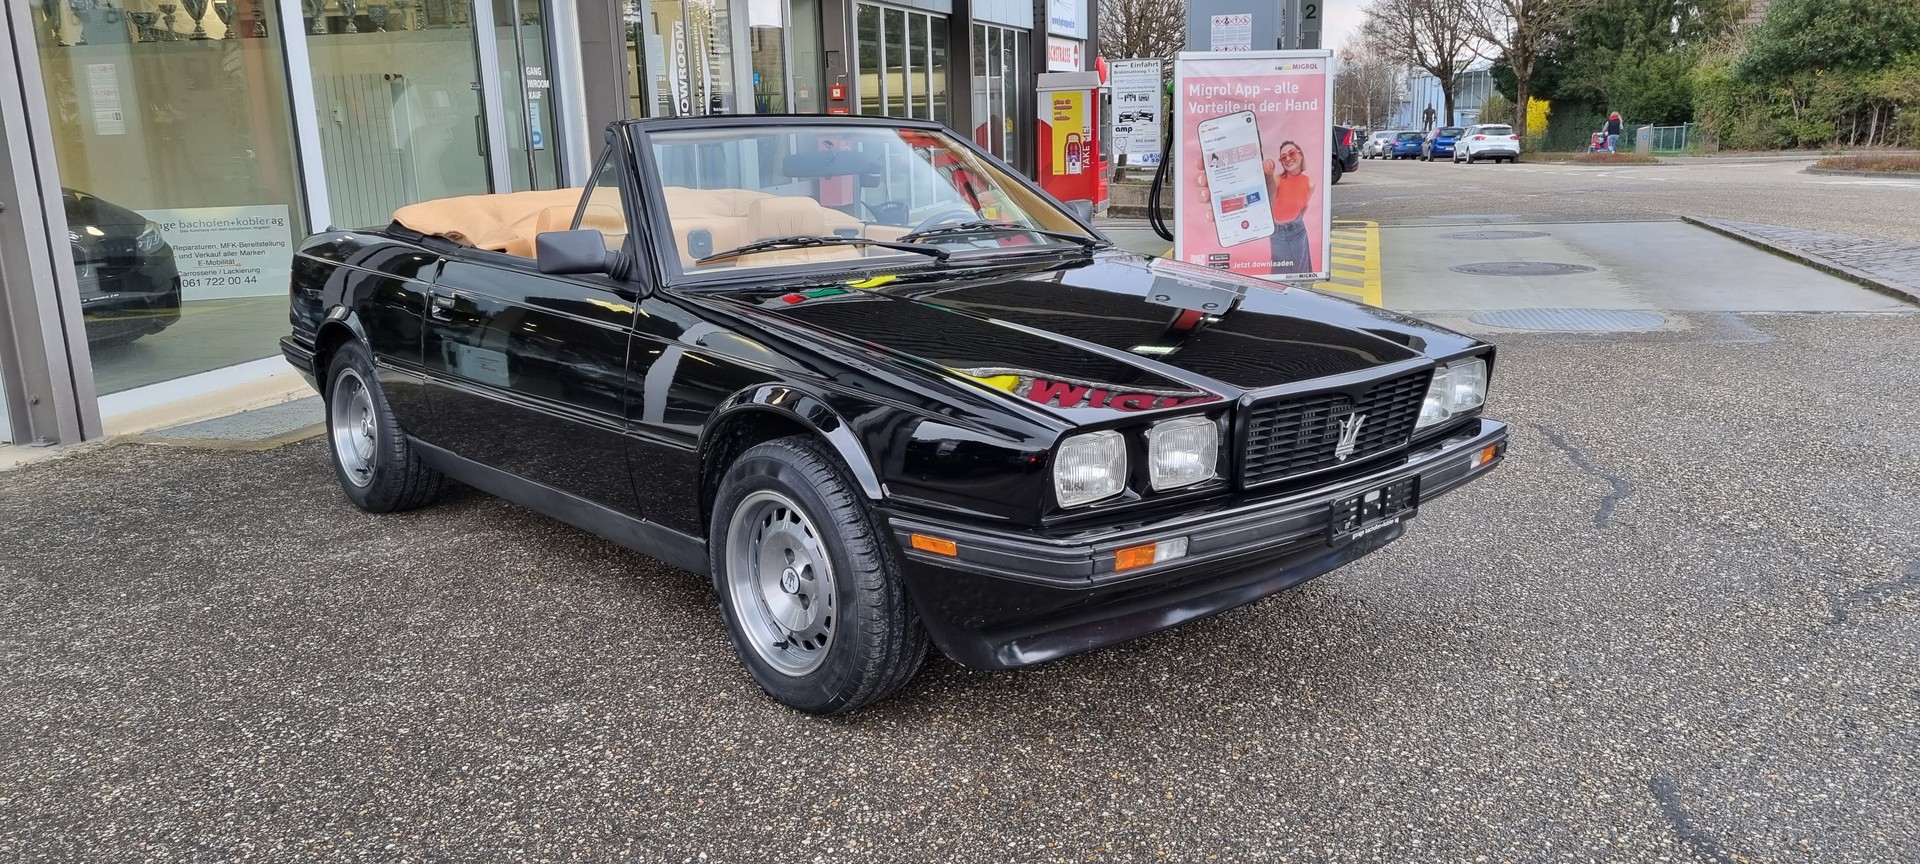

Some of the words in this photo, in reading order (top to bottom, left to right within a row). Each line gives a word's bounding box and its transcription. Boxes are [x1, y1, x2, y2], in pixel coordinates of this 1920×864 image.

[1305, 4, 1317, 19] 2
[1189, 83, 1232, 98] Migrol
[1234, 83, 1260, 98] App
[1274, 82, 1299, 94] alle
[1188, 100, 1241, 114] Vorteile
[1244, 100, 1256, 112] in
[1260, 100, 1281, 112] der
[1286, 98, 1318, 112] Hand
[179, 217, 269, 229] bachofen+kobler
[272, 218, 284, 226] ag
[220, 241, 285, 249] MFK-Bereitstellung
[1252, 260, 1294, 268] downloaden
[182, 279, 201, 288] 061
[206, 278, 224, 286] 722
[228, 276, 241, 285] 00
[244, 276, 257, 284] 44
[1352, 530, 1365, 540] garage
